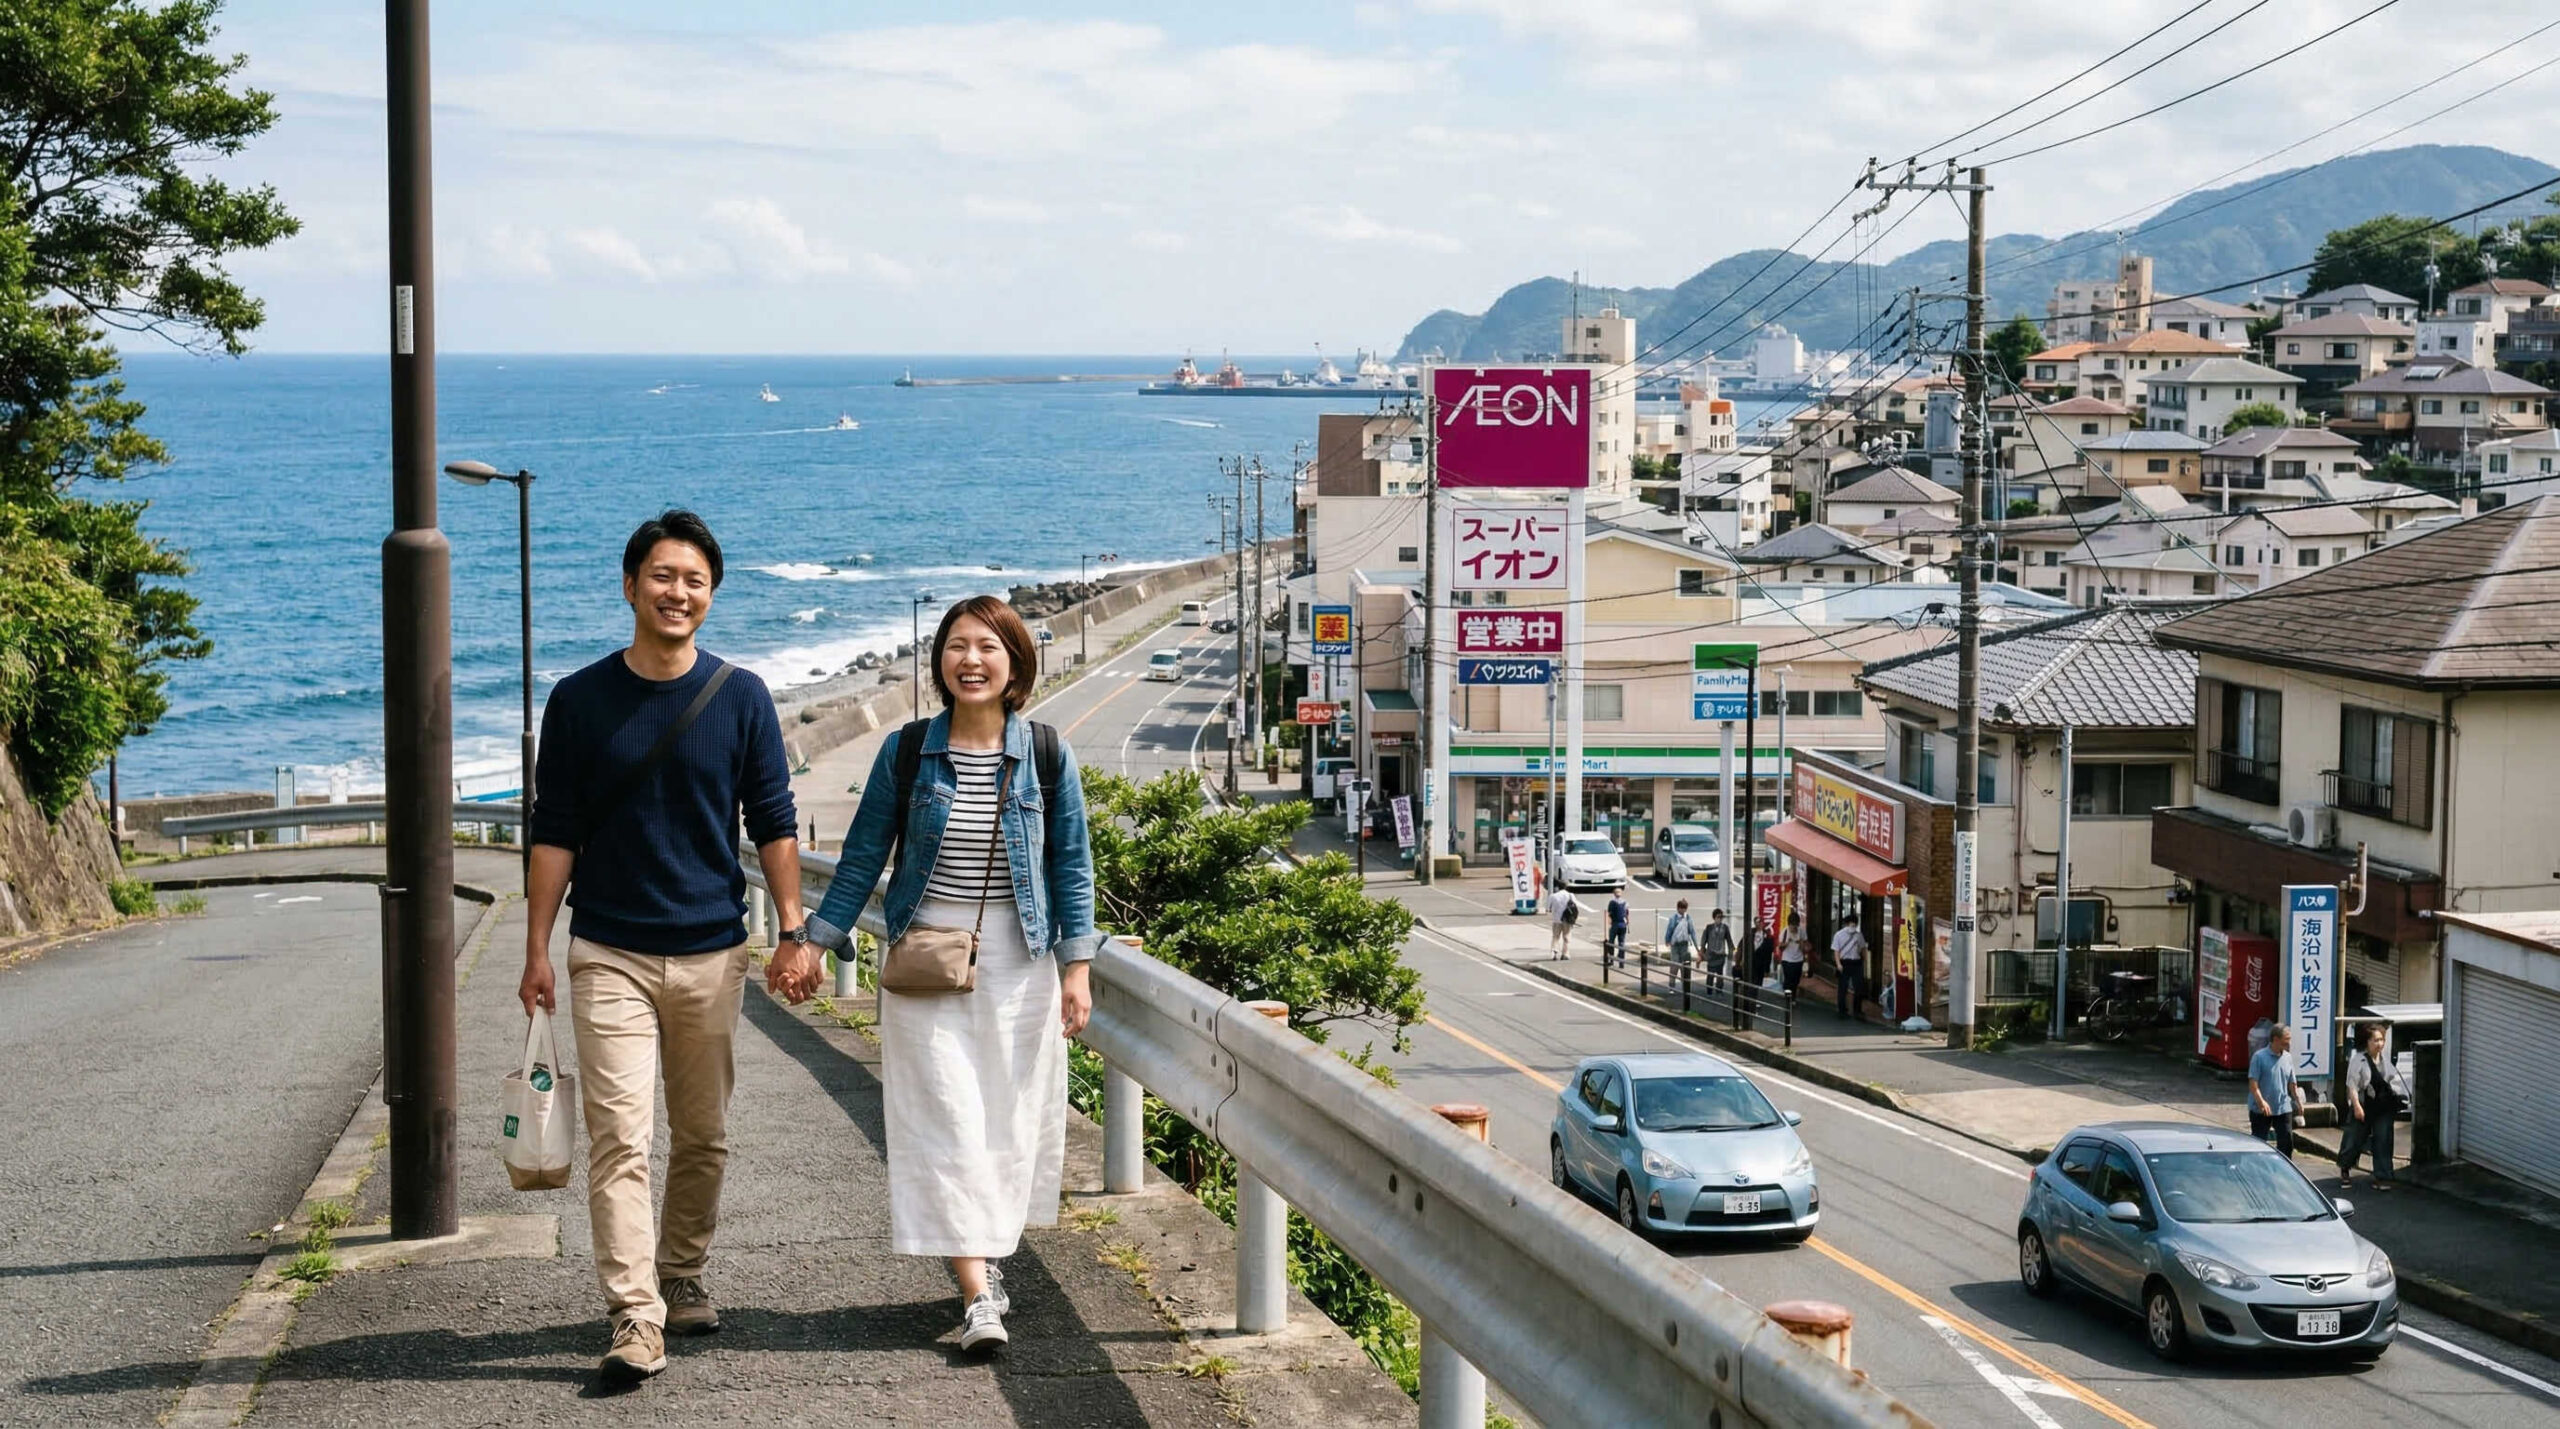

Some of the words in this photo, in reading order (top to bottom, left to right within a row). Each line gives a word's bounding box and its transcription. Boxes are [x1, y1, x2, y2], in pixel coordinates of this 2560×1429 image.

[1462, 516, 1560, 542] スーパー
[1461, 549, 1559, 580] イオン
[1462, 615, 1556, 648] 営業中
[2300, 918, 2323, 1069] 海沿い散歩コース
